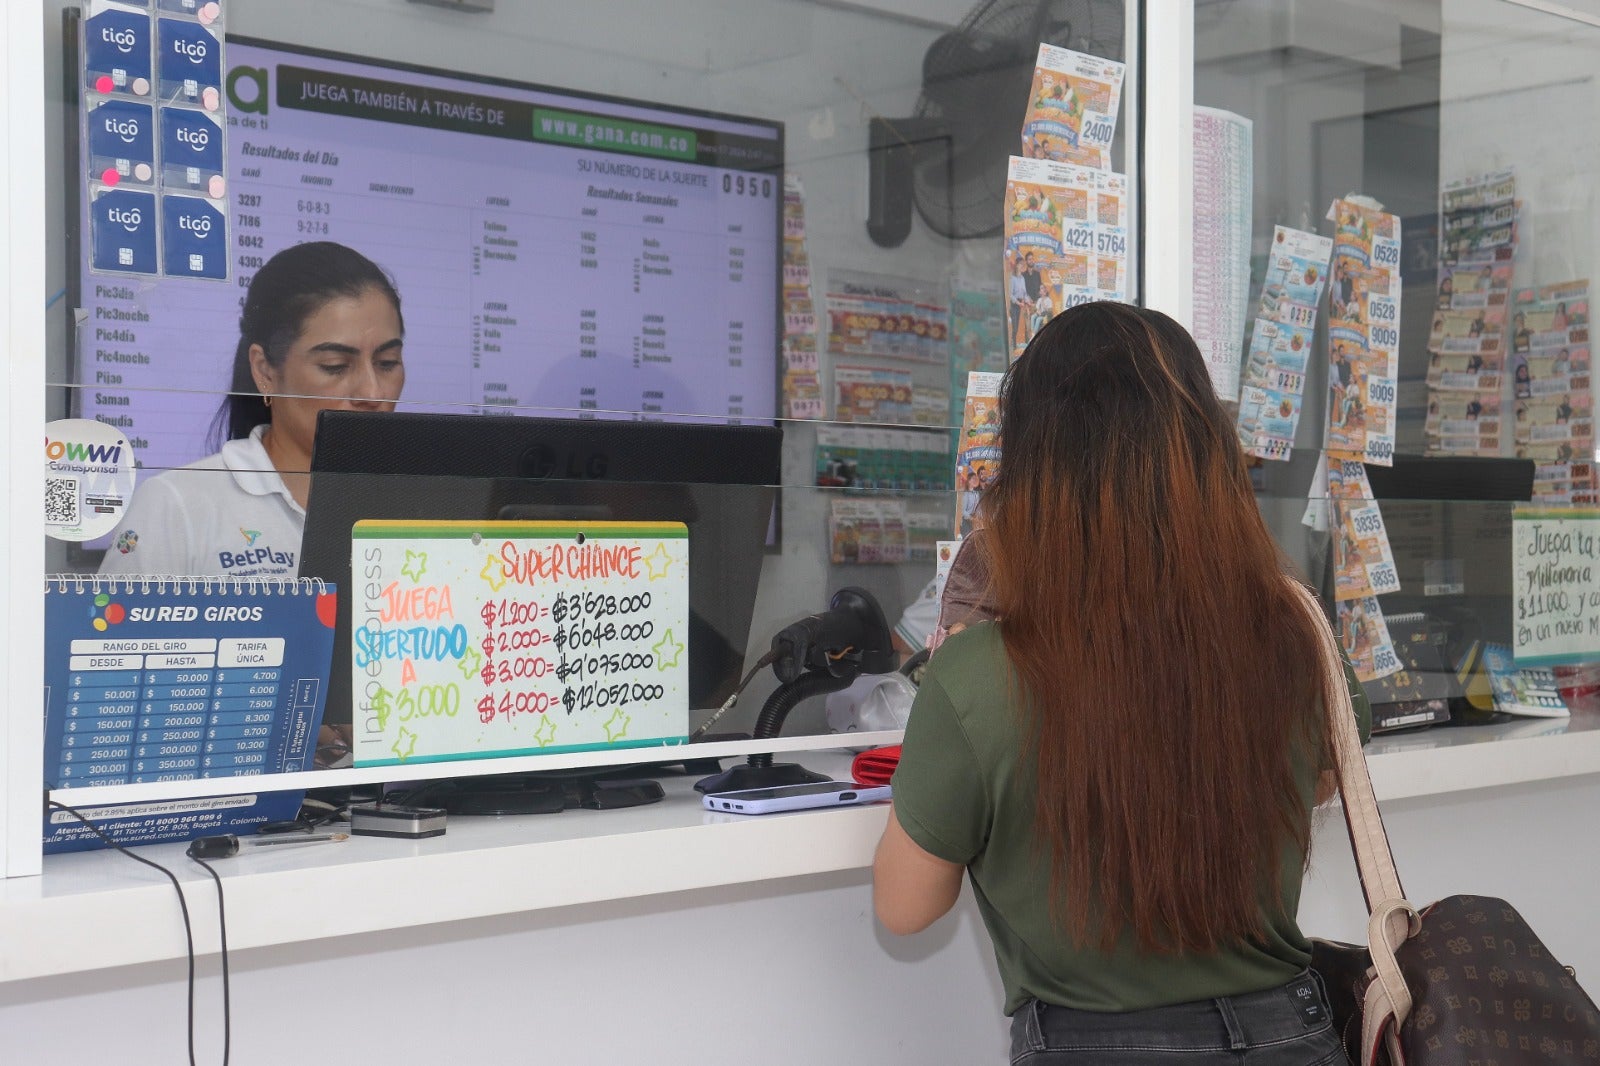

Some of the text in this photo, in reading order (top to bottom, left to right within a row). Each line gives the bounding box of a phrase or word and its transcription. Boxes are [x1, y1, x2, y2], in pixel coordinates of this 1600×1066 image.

[300, 81, 504, 125] JUEGA TAMBIÉN A TRAVÉS DE
[541, 118, 688, 153] www.gana.com.co
[1083, 120, 1112, 142] 2400
[242, 142, 339, 167] Resultados del Día
[577, 159, 708, 188] SU NÚMERO DE LA SUERTE
[238, 194, 330, 215] 3287 6-0-8-3
[587, 185, 679, 208] Resultados Semanales
[238, 214, 261, 228] 7186
[238, 234, 264, 249] 6042
[1066, 228, 1094, 248] 4221
[1098, 233, 1126, 254] 5764
[1374, 244, 1398, 264] 0528
[96, 306, 150, 323] Pic3noche
[1291, 306, 1313, 322] 0239
[1370, 301, 1396, 320] 0528
[96, 328, 136, 343] Pic4día
[1372, 326, 1397, 346] 9009
[96, 350, 150, 365] Pic4noche
[96, 372, 122, 386] Pijao
[1278, 372, 1301, 389] 0239
[1370, 384, 1394, 402] 9009
[45, 436, 124, 464] owwi
[1354, 514, 1382, 534] 3835
[1528, 525, 1572, 567] Juega
[219, 546, 294, 568] BetPlay
[501, 541, 642, 586] SUPER CHANCE
[1370, 570, 1396, 588] 3835
[1526, 563, 1592, 595] Millonaria
[380, 580, 454, 622] JUEGA
[129, 606, 264, 622] SU RED GIROS
[103, 642, 187, 652] RANGO DEL GIRO
[237, 643, 268, 651] TARIFA
[356, 624, 468, 668] SUERTUDO
[360, 547, 384, 744] Infoexpress
[90, 658, 124, 668] DESDE
[166, 658, 196, 666] HASTA
[236, 653, 264, 663] ÚNICA
[176, 674, 208, 682] 50.000
[252, 672, 277, 680] 4.700
[402, 658, 416, 686] A
[104, 686, 274, 700] 50.001 100.000 6.000
[98, 700, 272, 714] 100.001 150.000 7.500
[96, 714, 270, 729] 150.001 200.000 8.300
[92, 728, 268, 744] 200.001 250.000 9.700
[91, 741, 264, 759] 250.001 300.000 10.300
[89, 754, 262, 774] 300.001 350.000 10.800
[148, 804, 168, 813] sobre
[109, 820, 142, 830] cliente:
[144, 819, 154, 827] 01
[126, 828, 147, 836] Torre
[192, 820, 221, 830] Bogotá
[230, 816, 268, 825] Colombia
[105, 830, 190, 844] ww.sured.com.co
